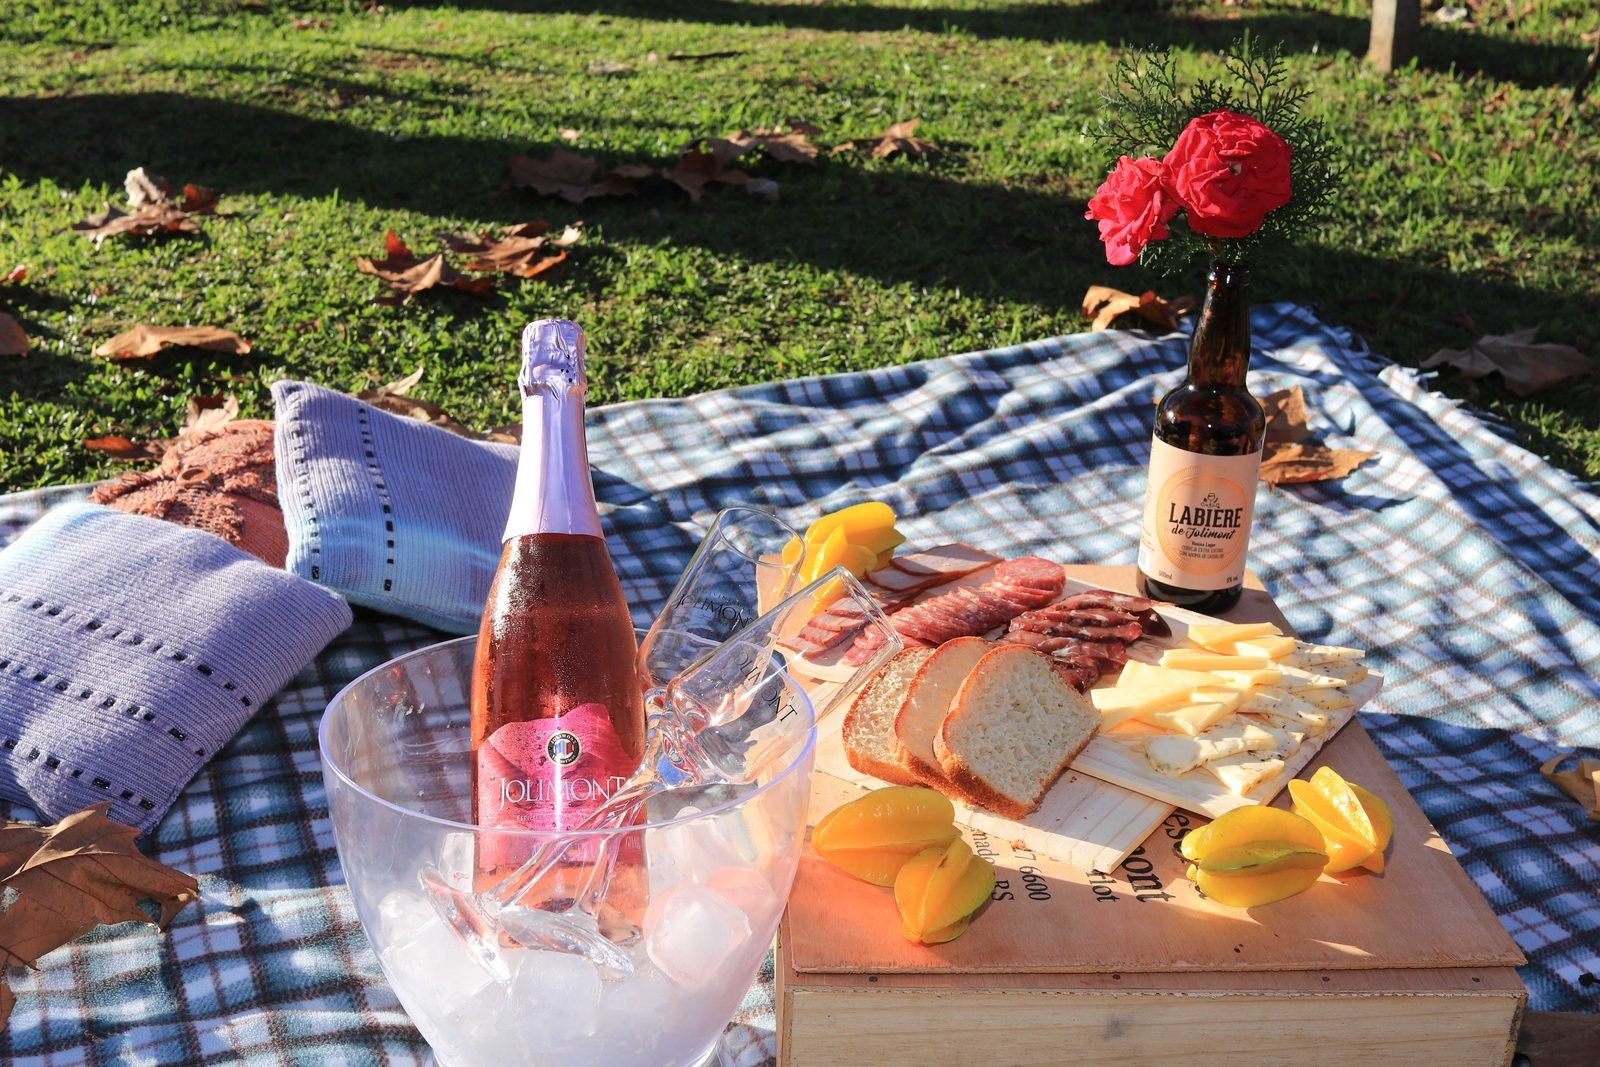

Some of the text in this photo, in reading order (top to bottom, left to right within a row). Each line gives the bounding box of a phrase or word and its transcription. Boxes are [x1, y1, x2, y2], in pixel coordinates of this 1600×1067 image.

[1171, 524, 1236, 540] de Jolimont
[991, 880, 1015, 901] RS
[1020, 865, 1051, 901] 6600
